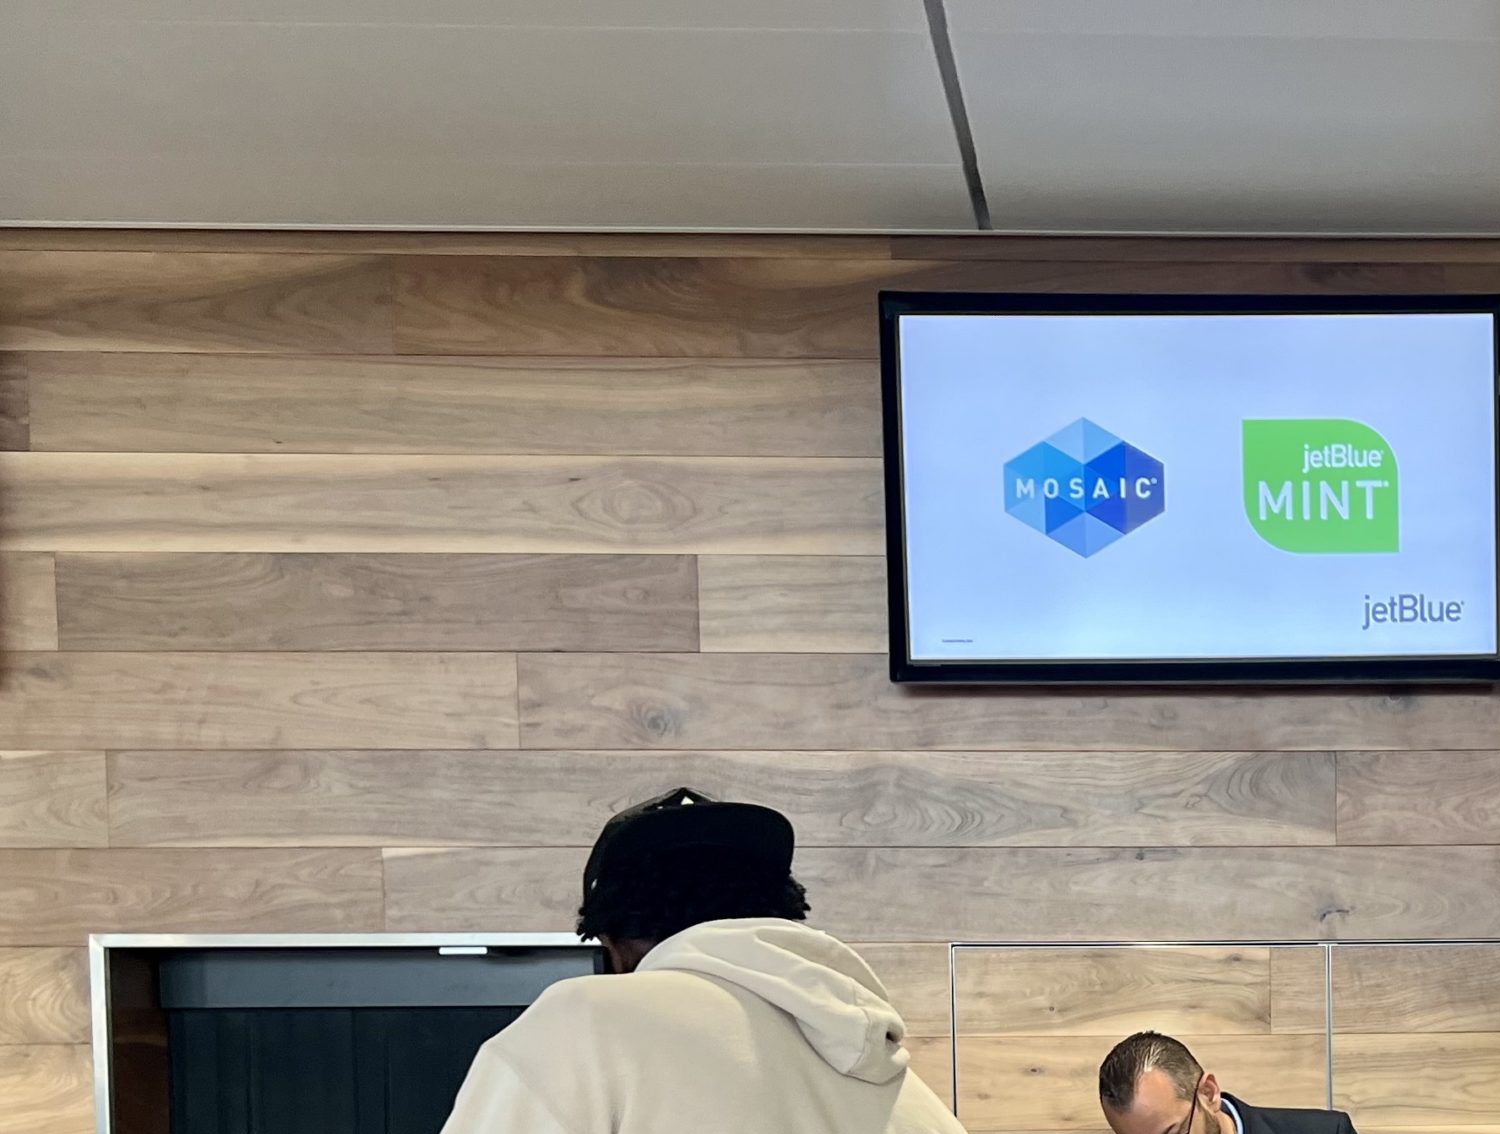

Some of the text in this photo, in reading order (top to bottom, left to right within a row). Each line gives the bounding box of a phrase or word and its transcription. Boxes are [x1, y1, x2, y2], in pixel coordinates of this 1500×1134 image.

[1302, 443, 1383, 473] jetBlue
[1015, 477, 1153, 500] MOSAIC
[1258, 480, 1388, 521] MINT
[1362, 593, 1462, 630] jetBlue
